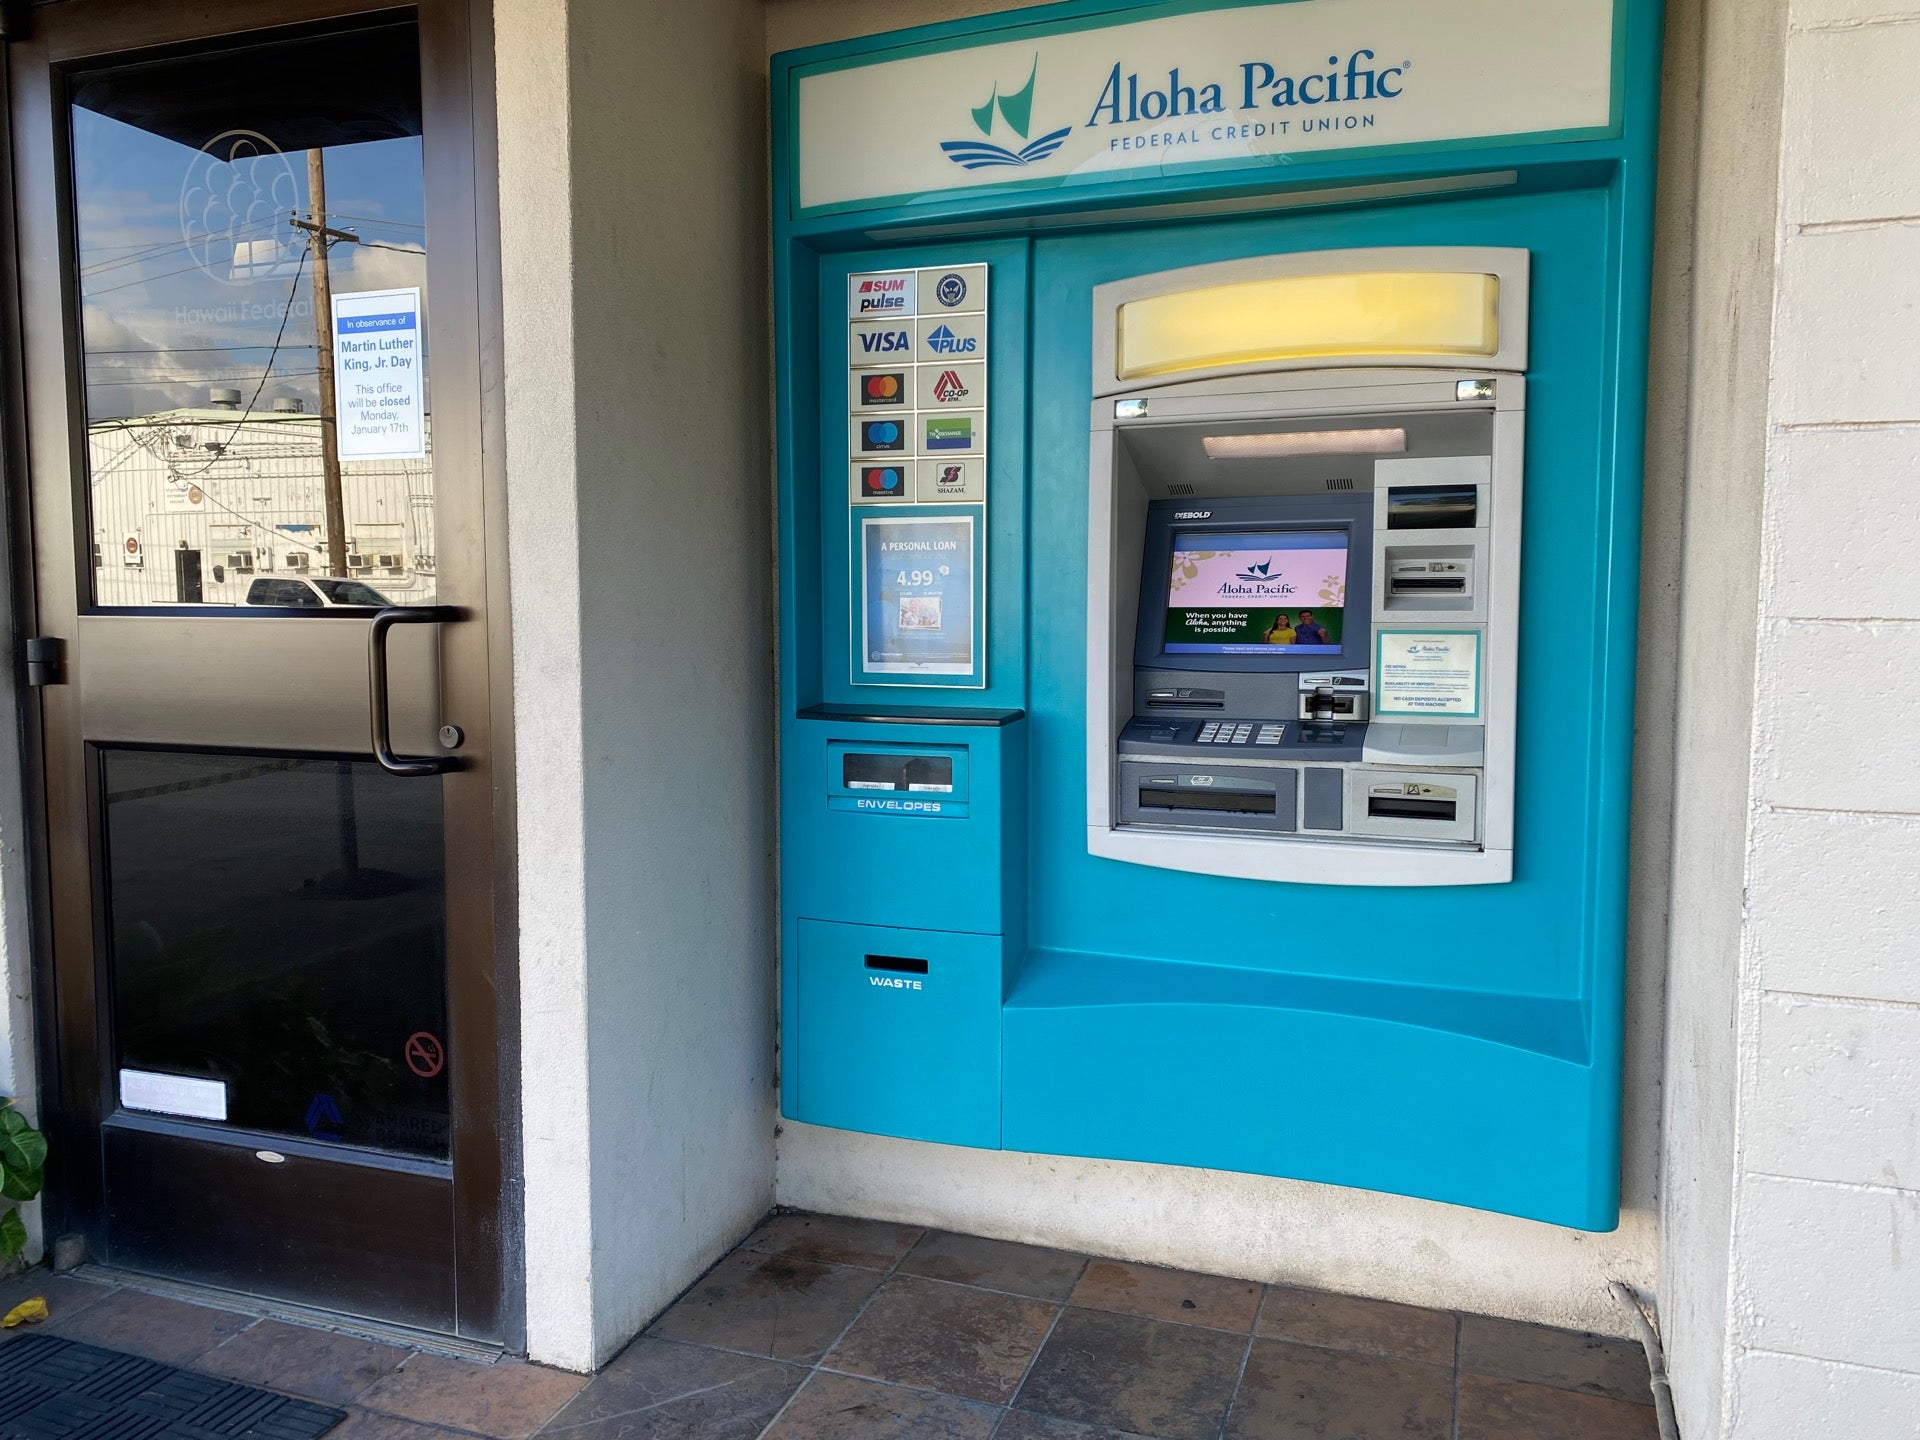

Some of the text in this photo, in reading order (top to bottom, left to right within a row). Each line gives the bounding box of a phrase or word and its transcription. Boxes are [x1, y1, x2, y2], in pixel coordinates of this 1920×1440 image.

[1085, 49, 1403, 128] Aloha Pacific
[1110, 114, 1376, 152] FEDERAL CREDIT UNION
[873, 279, 905, 292] SUM
[860, 293, 905, 312] pulse
[175, 296, 314, 325] Hawaii Federal
[347, 316, 406, 329] In observance of
[341, 338, 414, 353] Martin Luther
[857, 331, 910, 353] VISA
[938, 338, 977, 354] PLUS
[344, 355, 412, 372] King, Jr. Day
[355, 382, 402, 395] This office
[943, 389, 969, 398] CO-OP
[348, 395, 411, 408] will be closed
[360, 410, 399, 421] Monday,
[351, 422, 409, 436] January 17th
[1174, 511, 1212, 520] DIEBOLD
[881, 541, 957, 551] A PERSONAL LOAN
[897, 570, 933, 586] 4.99
[1217, 582, 1296, 594] Aloha Pacific
[1211, 619, 1247, 627] anything
[857, 800, 941, 812] ENVELOPES
[869, 976, 922, 990] WASTE
